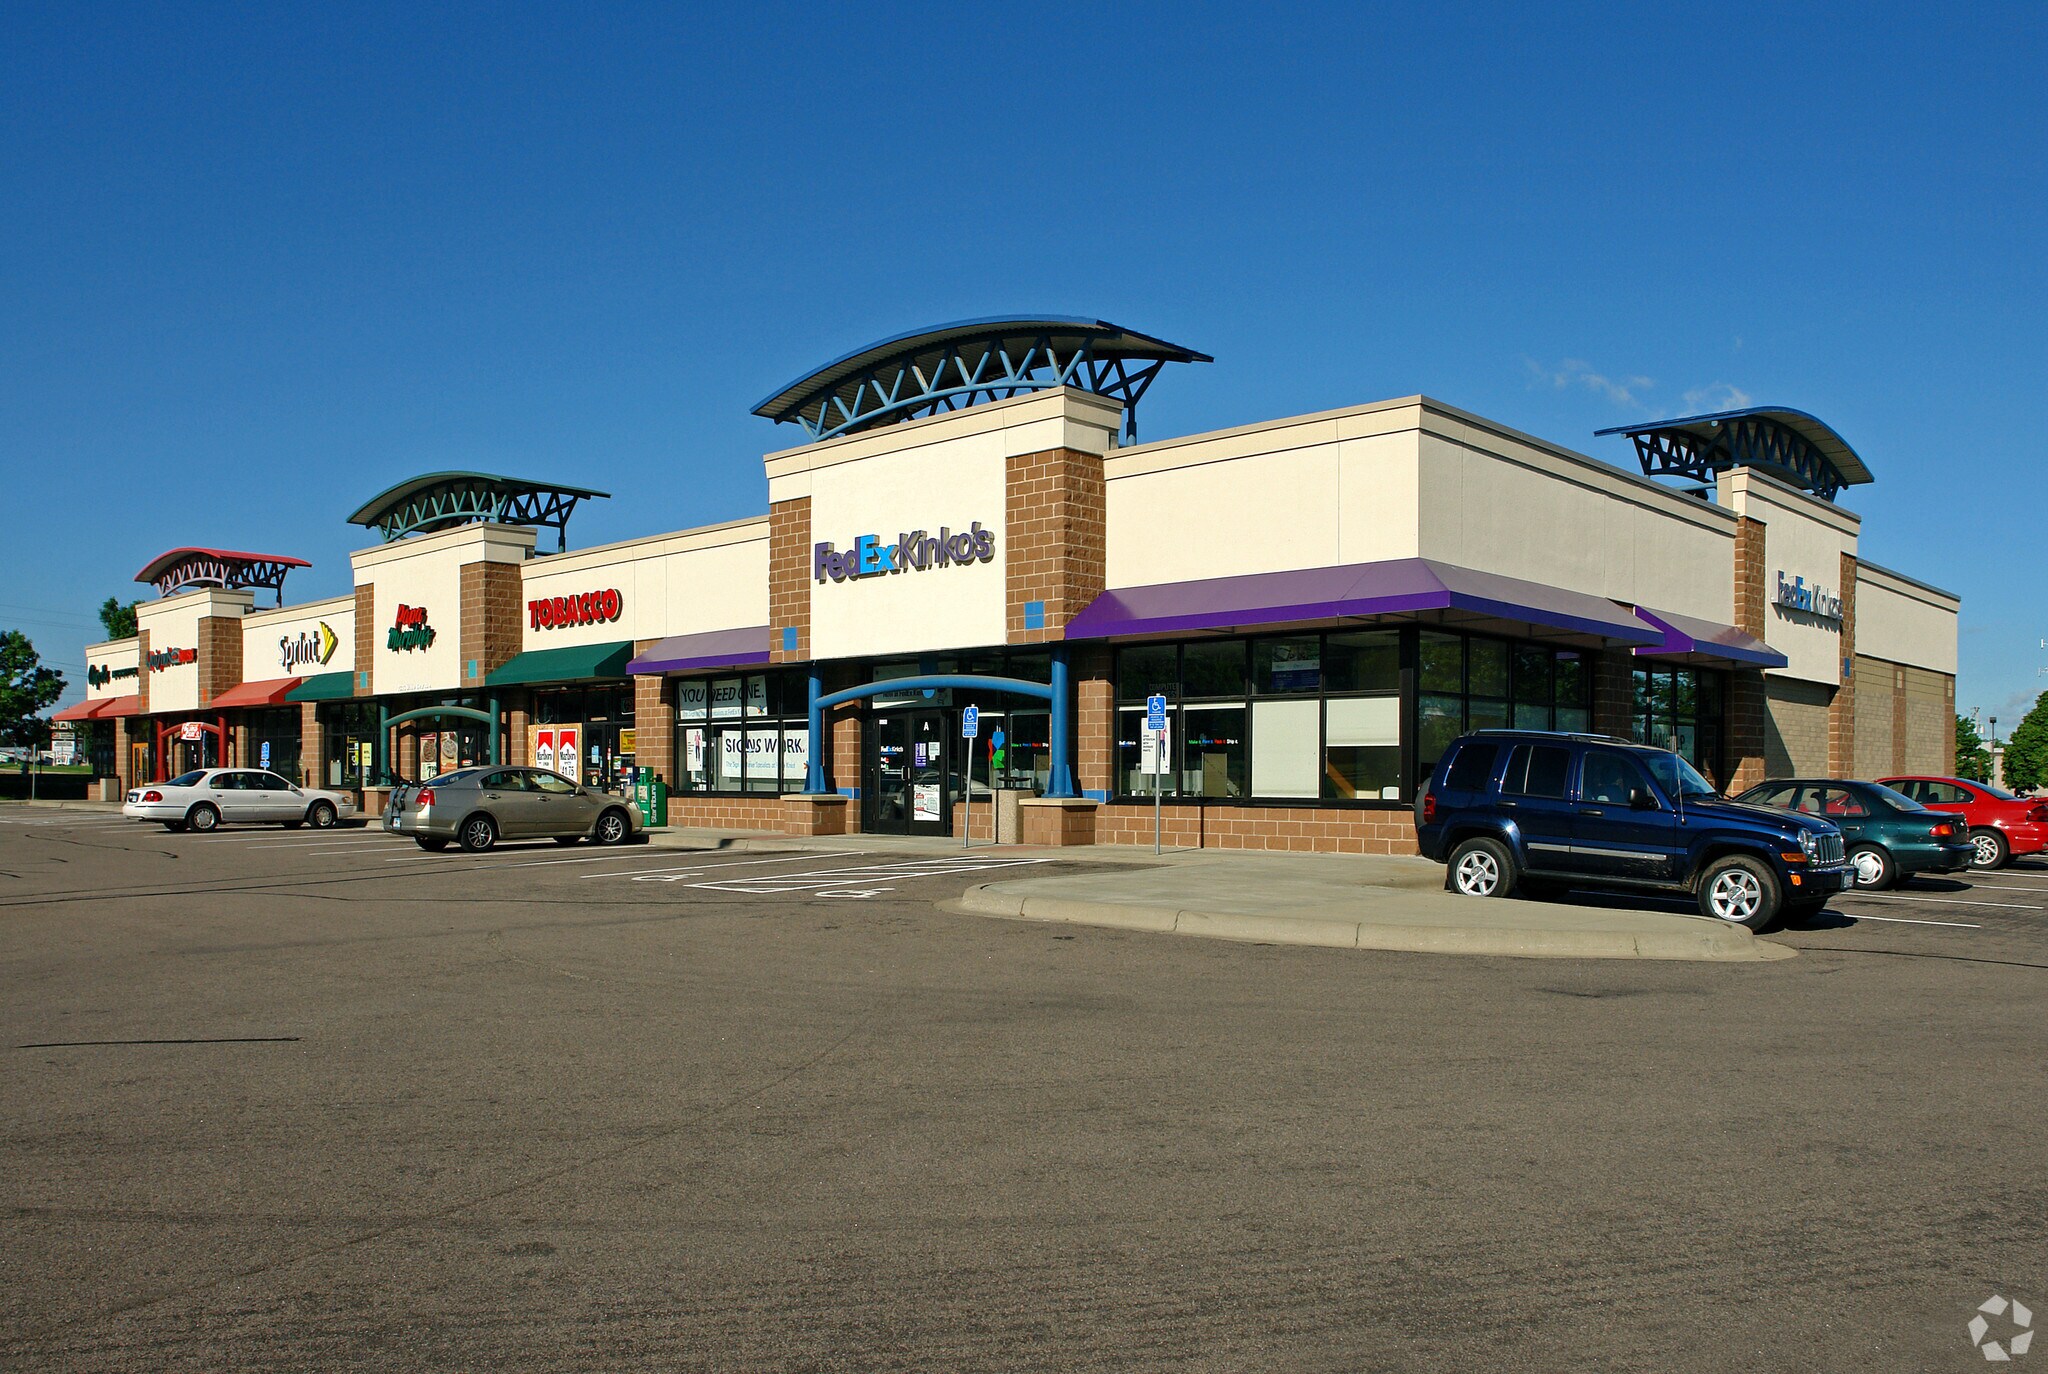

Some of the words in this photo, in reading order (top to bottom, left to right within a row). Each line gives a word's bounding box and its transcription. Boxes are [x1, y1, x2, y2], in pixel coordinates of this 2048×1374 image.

[528, 588, 623, 631] TOBACCO
[278, 630, 321, 674] Sprint
[681, 688, 705, 702] YOU
[923, 721, 930, 731] A
[764, 738, 805, 753] WRK.
